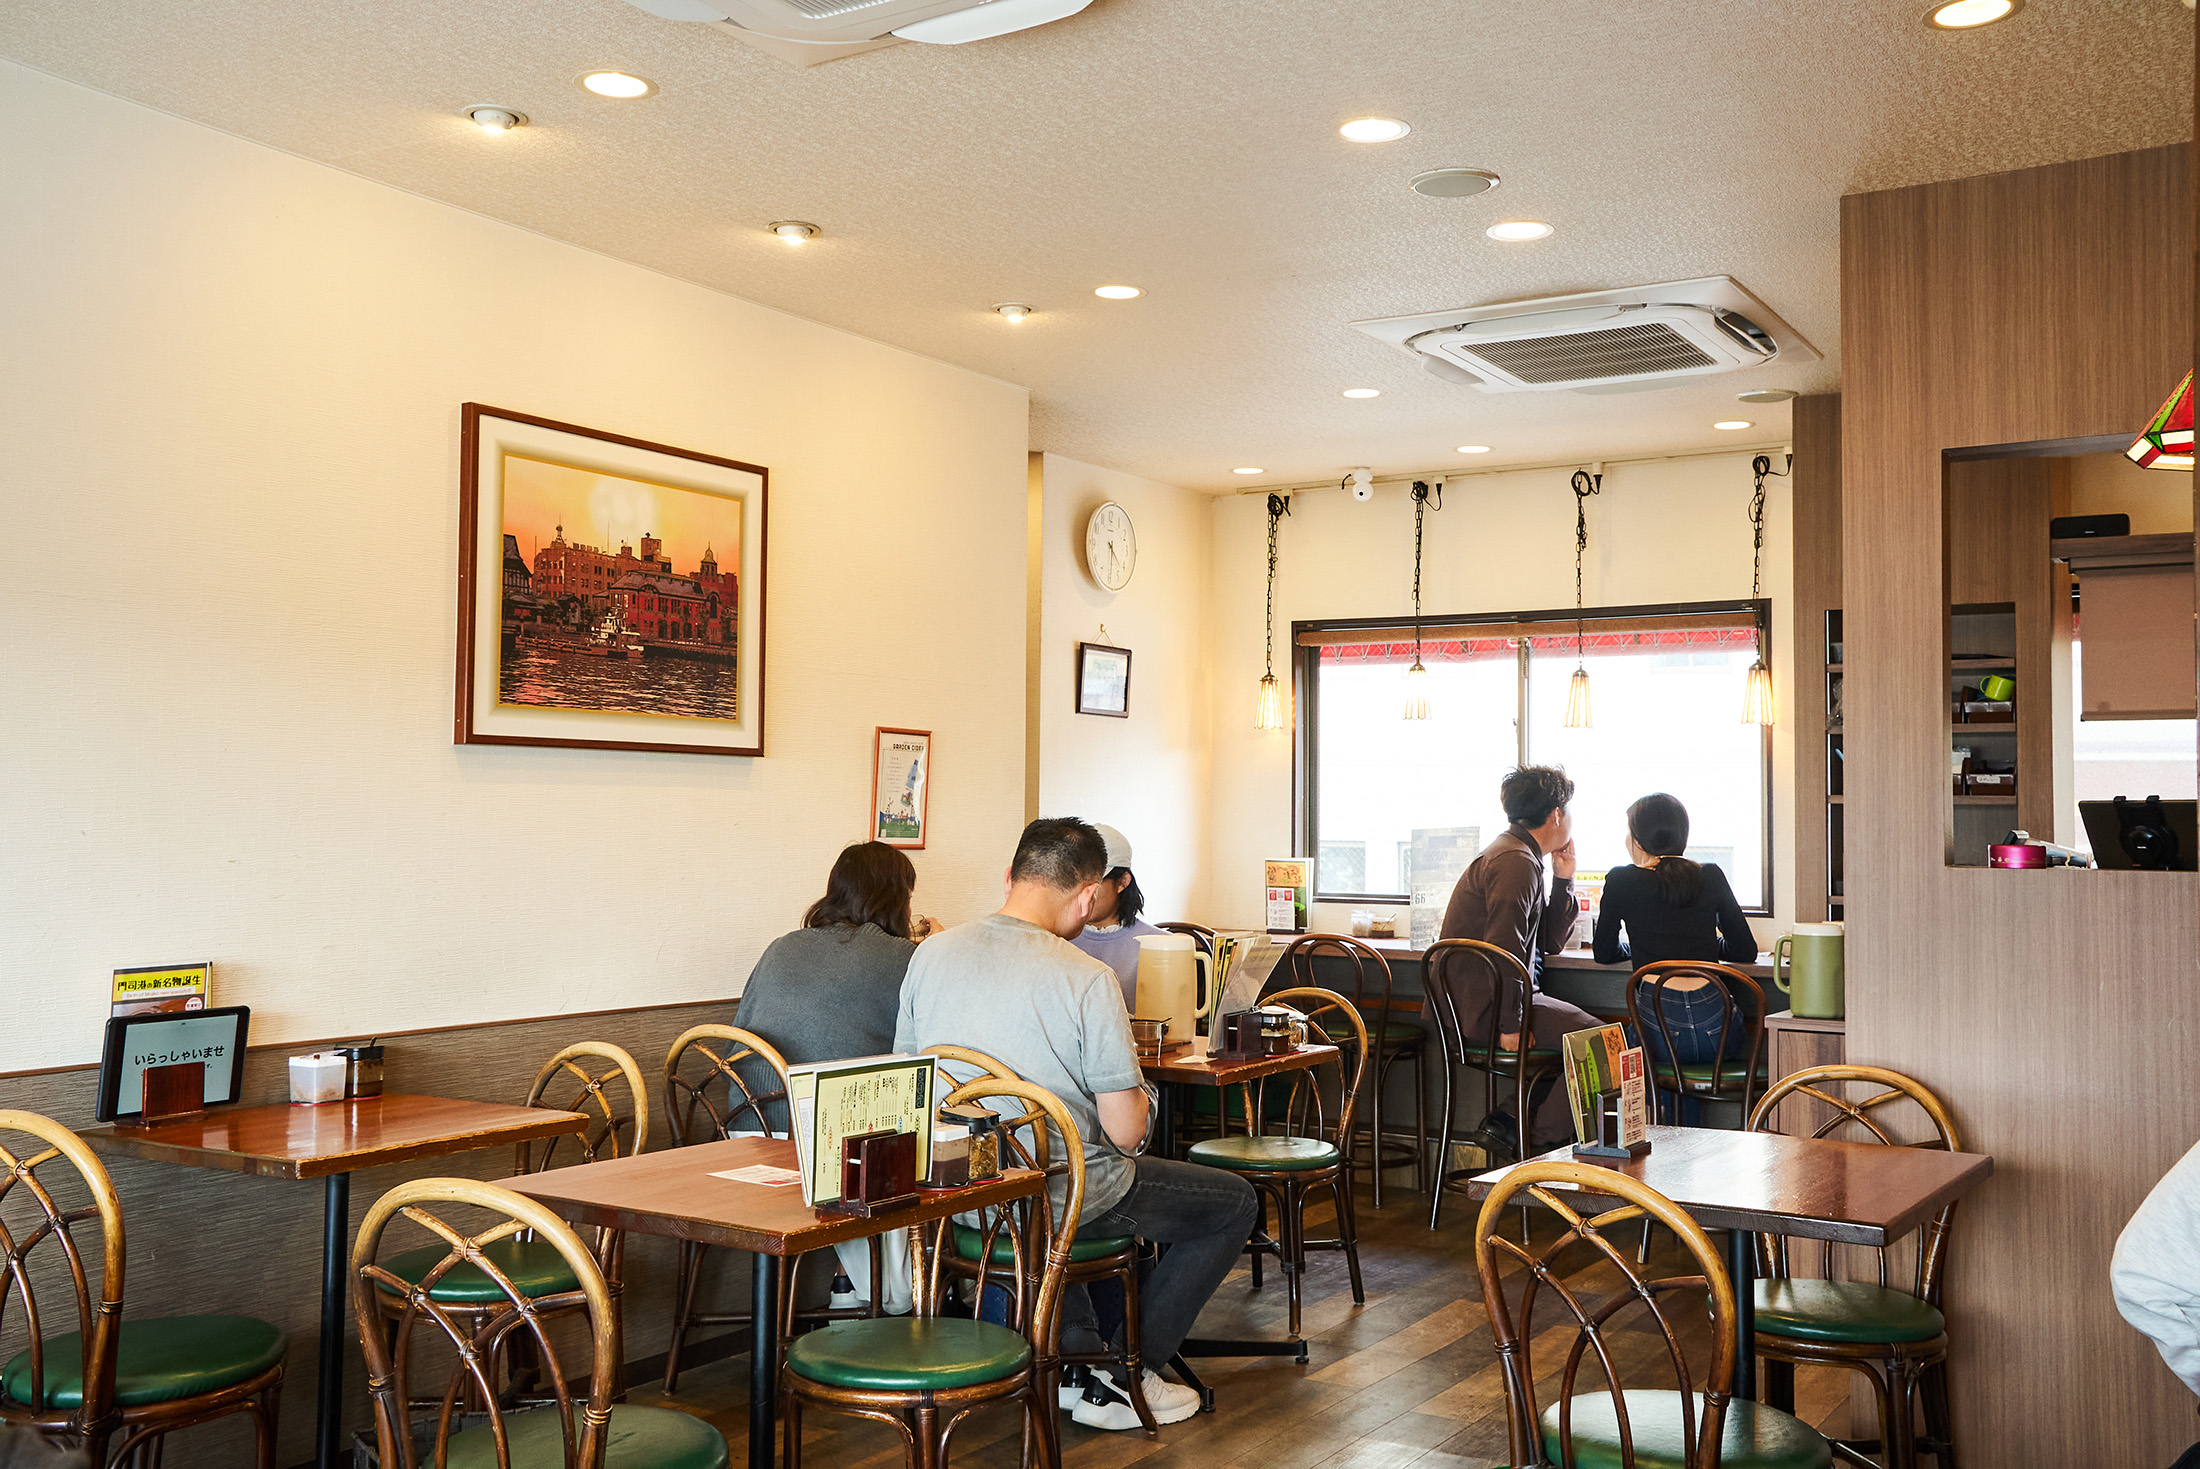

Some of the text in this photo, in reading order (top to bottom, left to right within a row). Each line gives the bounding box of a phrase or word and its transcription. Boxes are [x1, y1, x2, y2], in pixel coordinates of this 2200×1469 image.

[117, 974, 202, 991] 門司港の新名物誕生
[134, 1045, 225, 1066] いらっしゃいませ
